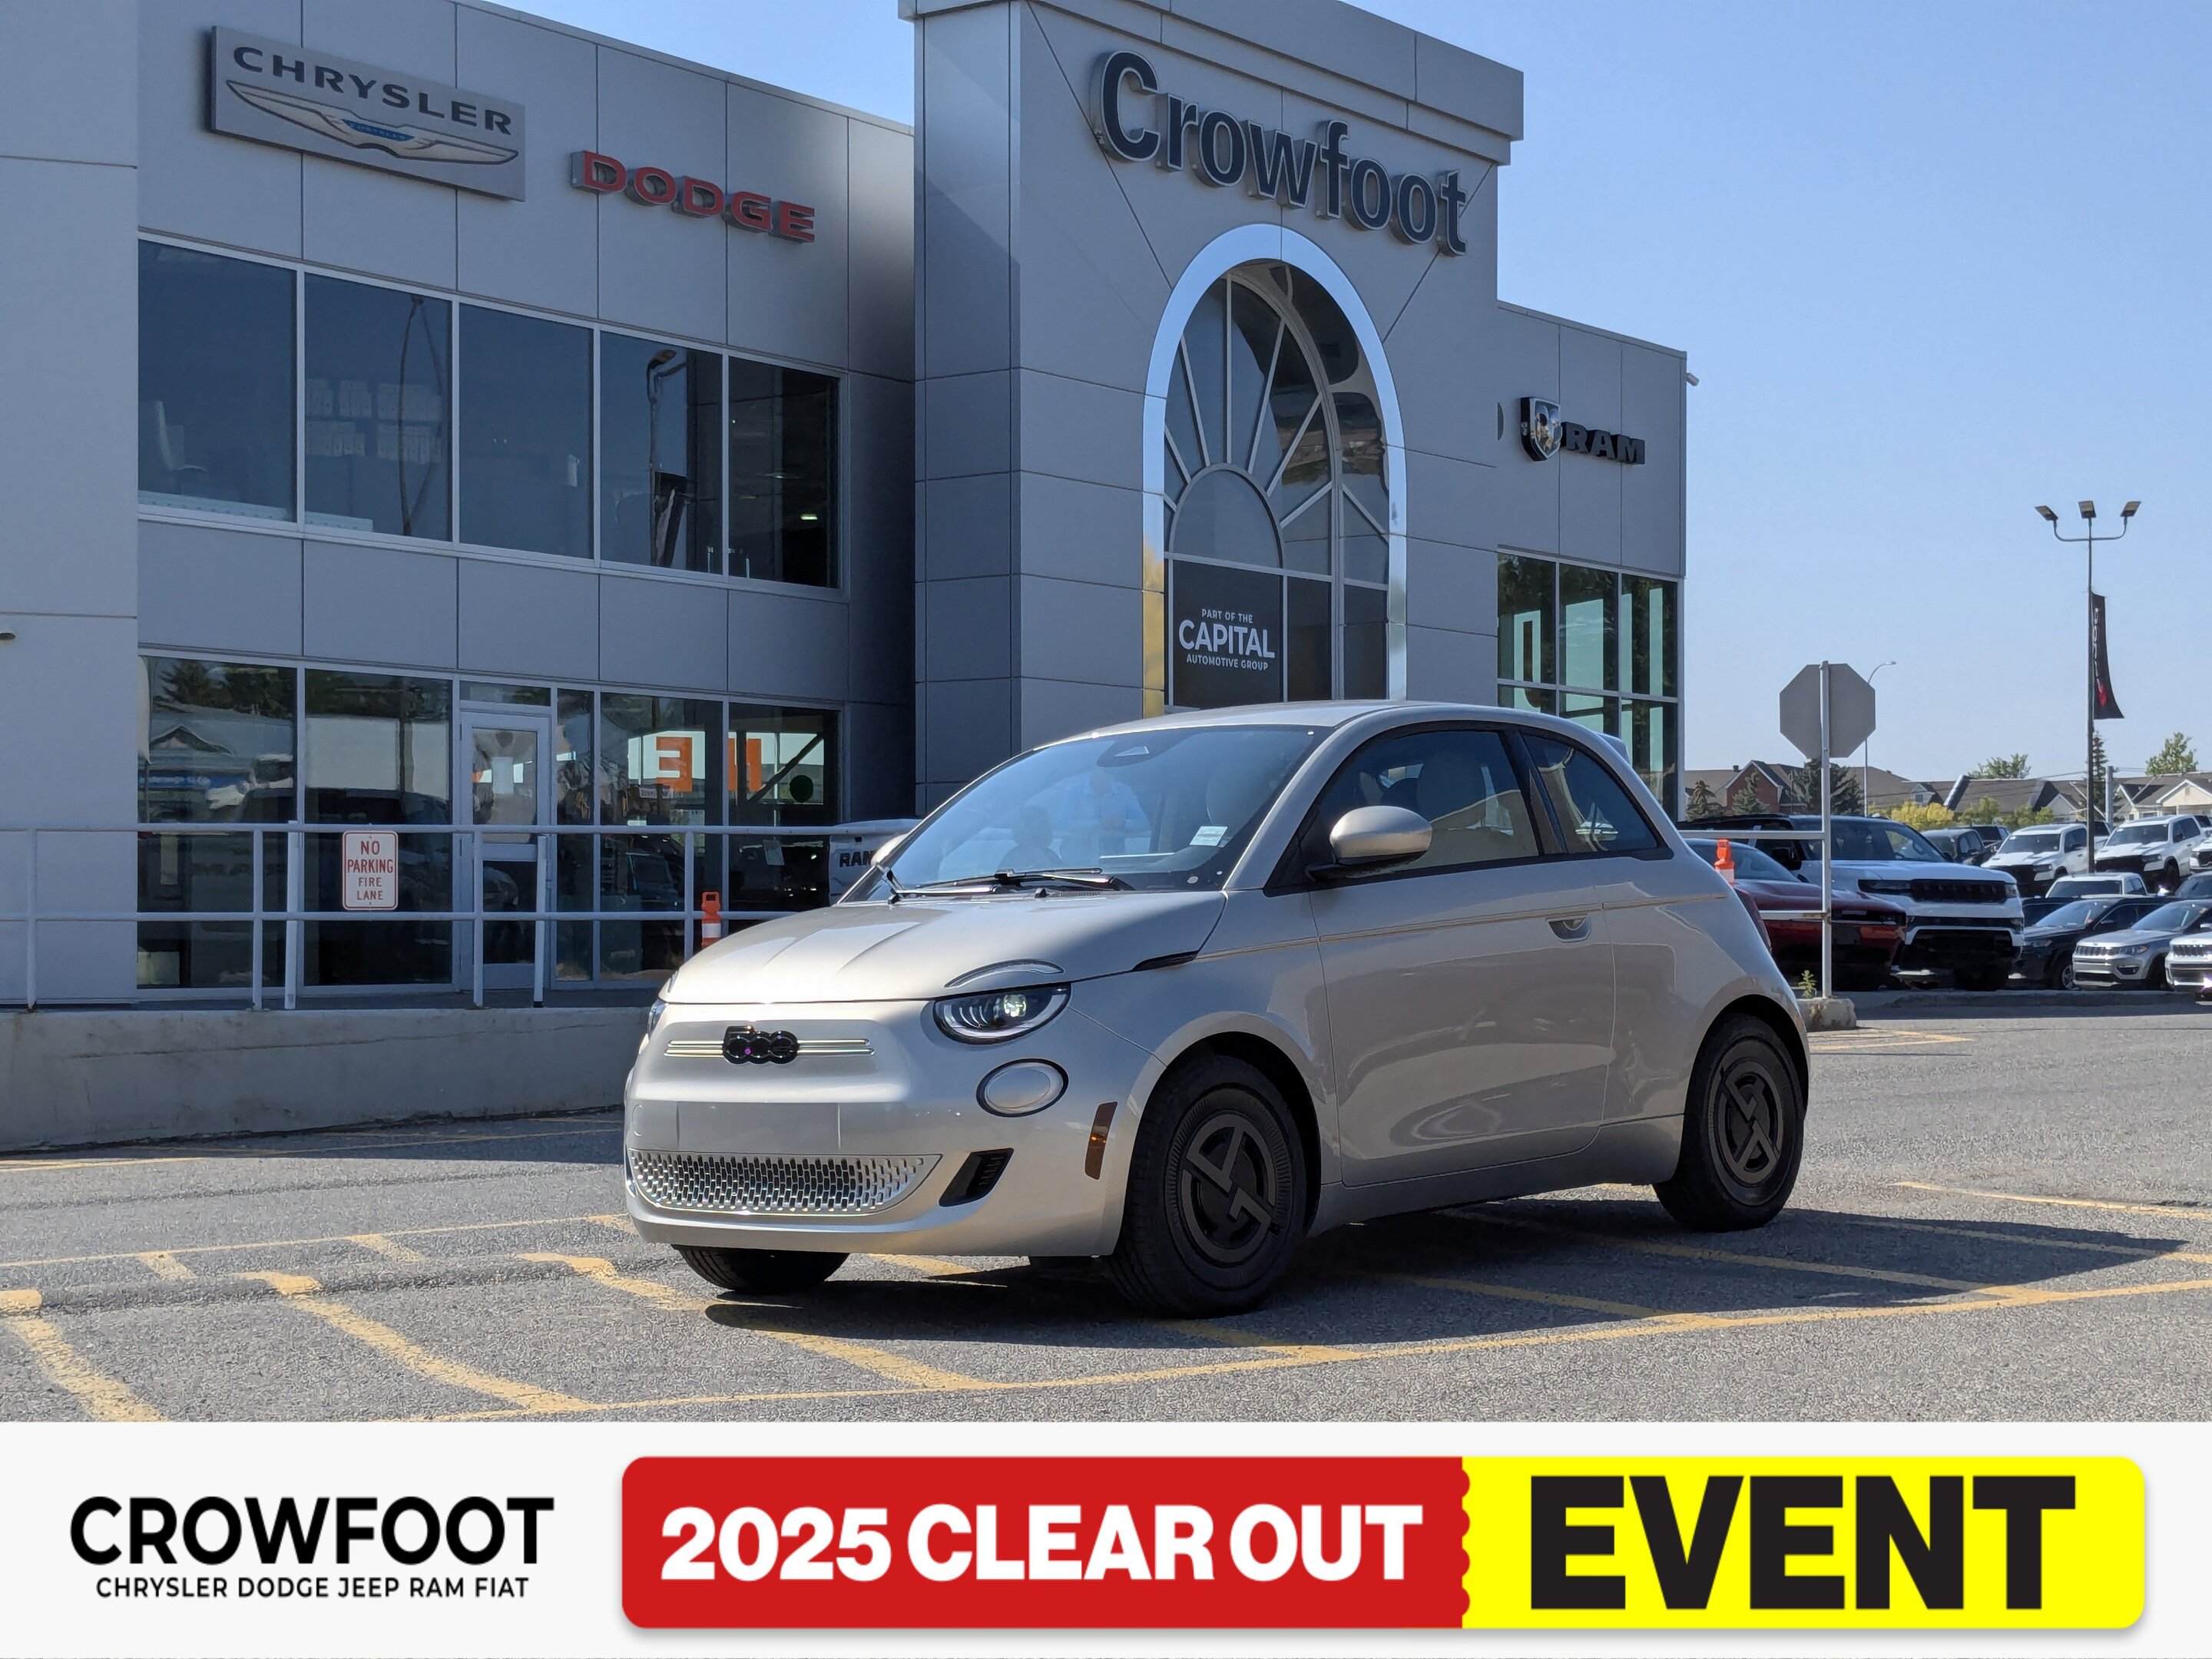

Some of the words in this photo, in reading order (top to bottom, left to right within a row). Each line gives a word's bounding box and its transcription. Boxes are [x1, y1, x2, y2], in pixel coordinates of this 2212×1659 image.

[233, 46, 512, 135] CHRYSLER
[1091, 49, 1468, 257] Crowfoot
[573, 150, 816, 243] DODGE
[1561, 422, 1646, 465] RAM
[1201, 608, 1223, 619] PART
[1224, 612, 1236, 621] OF
[1238, 613, 1253, 623] THE
[1179, 619, 1275, 658] CAPITAL
[1187, 654, 1239, 668] AUTOMOTIVE
[1240, 660, 1269, 671] GROUP
[360, 840, 380, 855] NO
[347, 859, 394, 873] PARKING
[358, 876, 382, 887] FIRE
[356, 890, 384, 901] LANE
